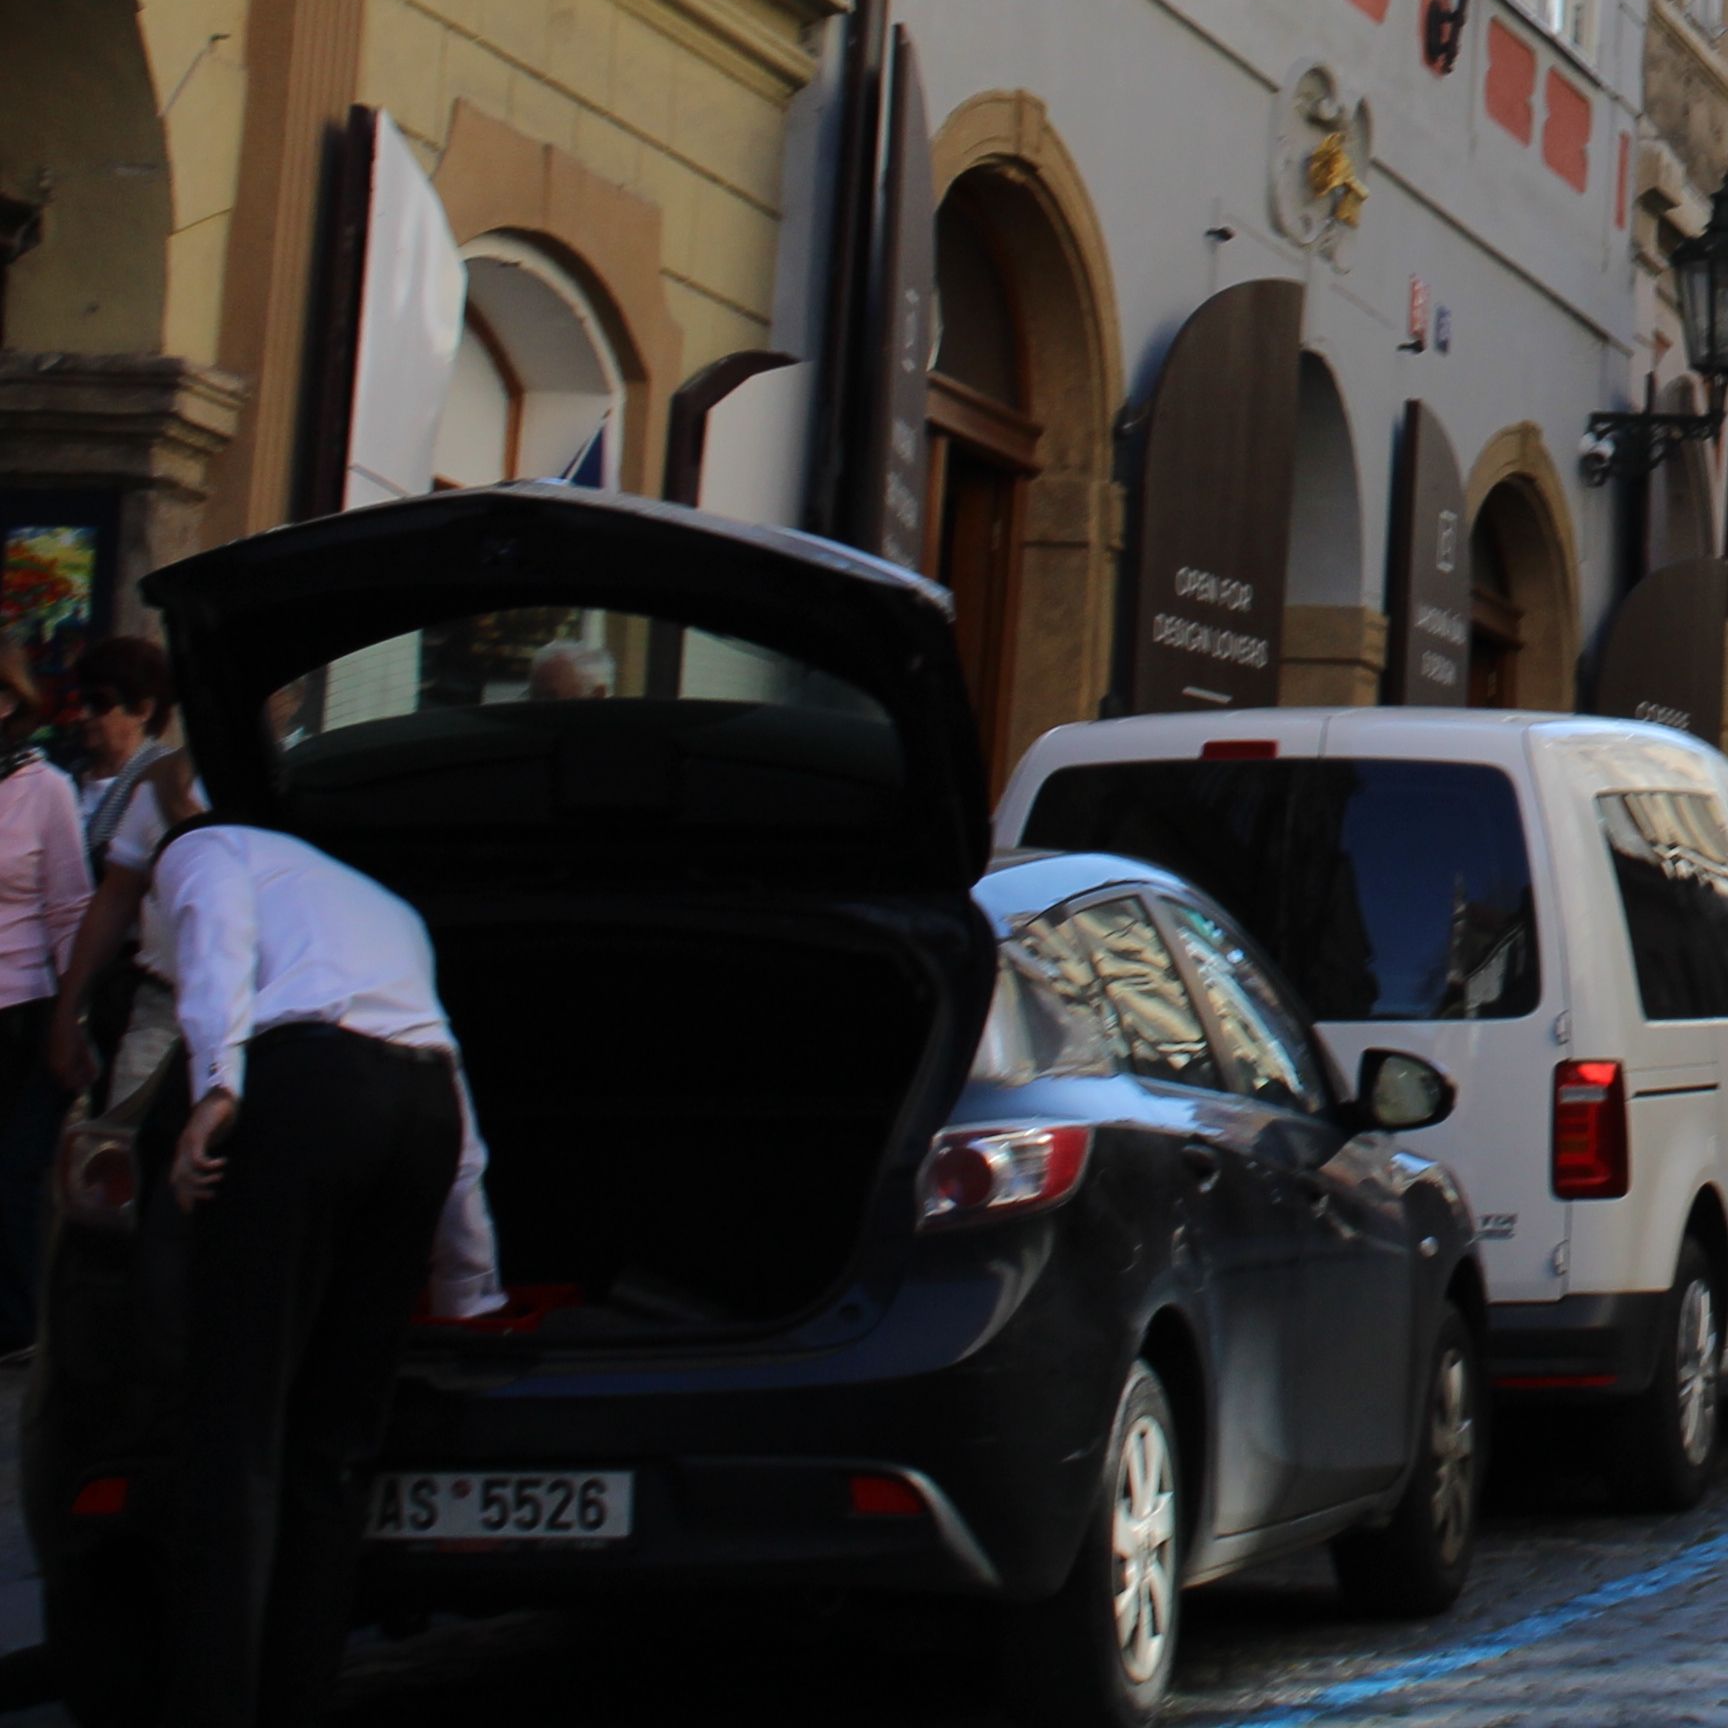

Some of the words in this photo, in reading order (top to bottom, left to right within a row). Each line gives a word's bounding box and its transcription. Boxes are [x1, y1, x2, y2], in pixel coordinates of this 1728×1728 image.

[1174, 565, 1218, 605] OPEN
[1218, 577, 1255, 613] FOR
[1152, 611, 1213, 654] DESIGN
[1211, 627, 1270, 671] LOVERS
[478, 1476, 609, 1533] 5526
